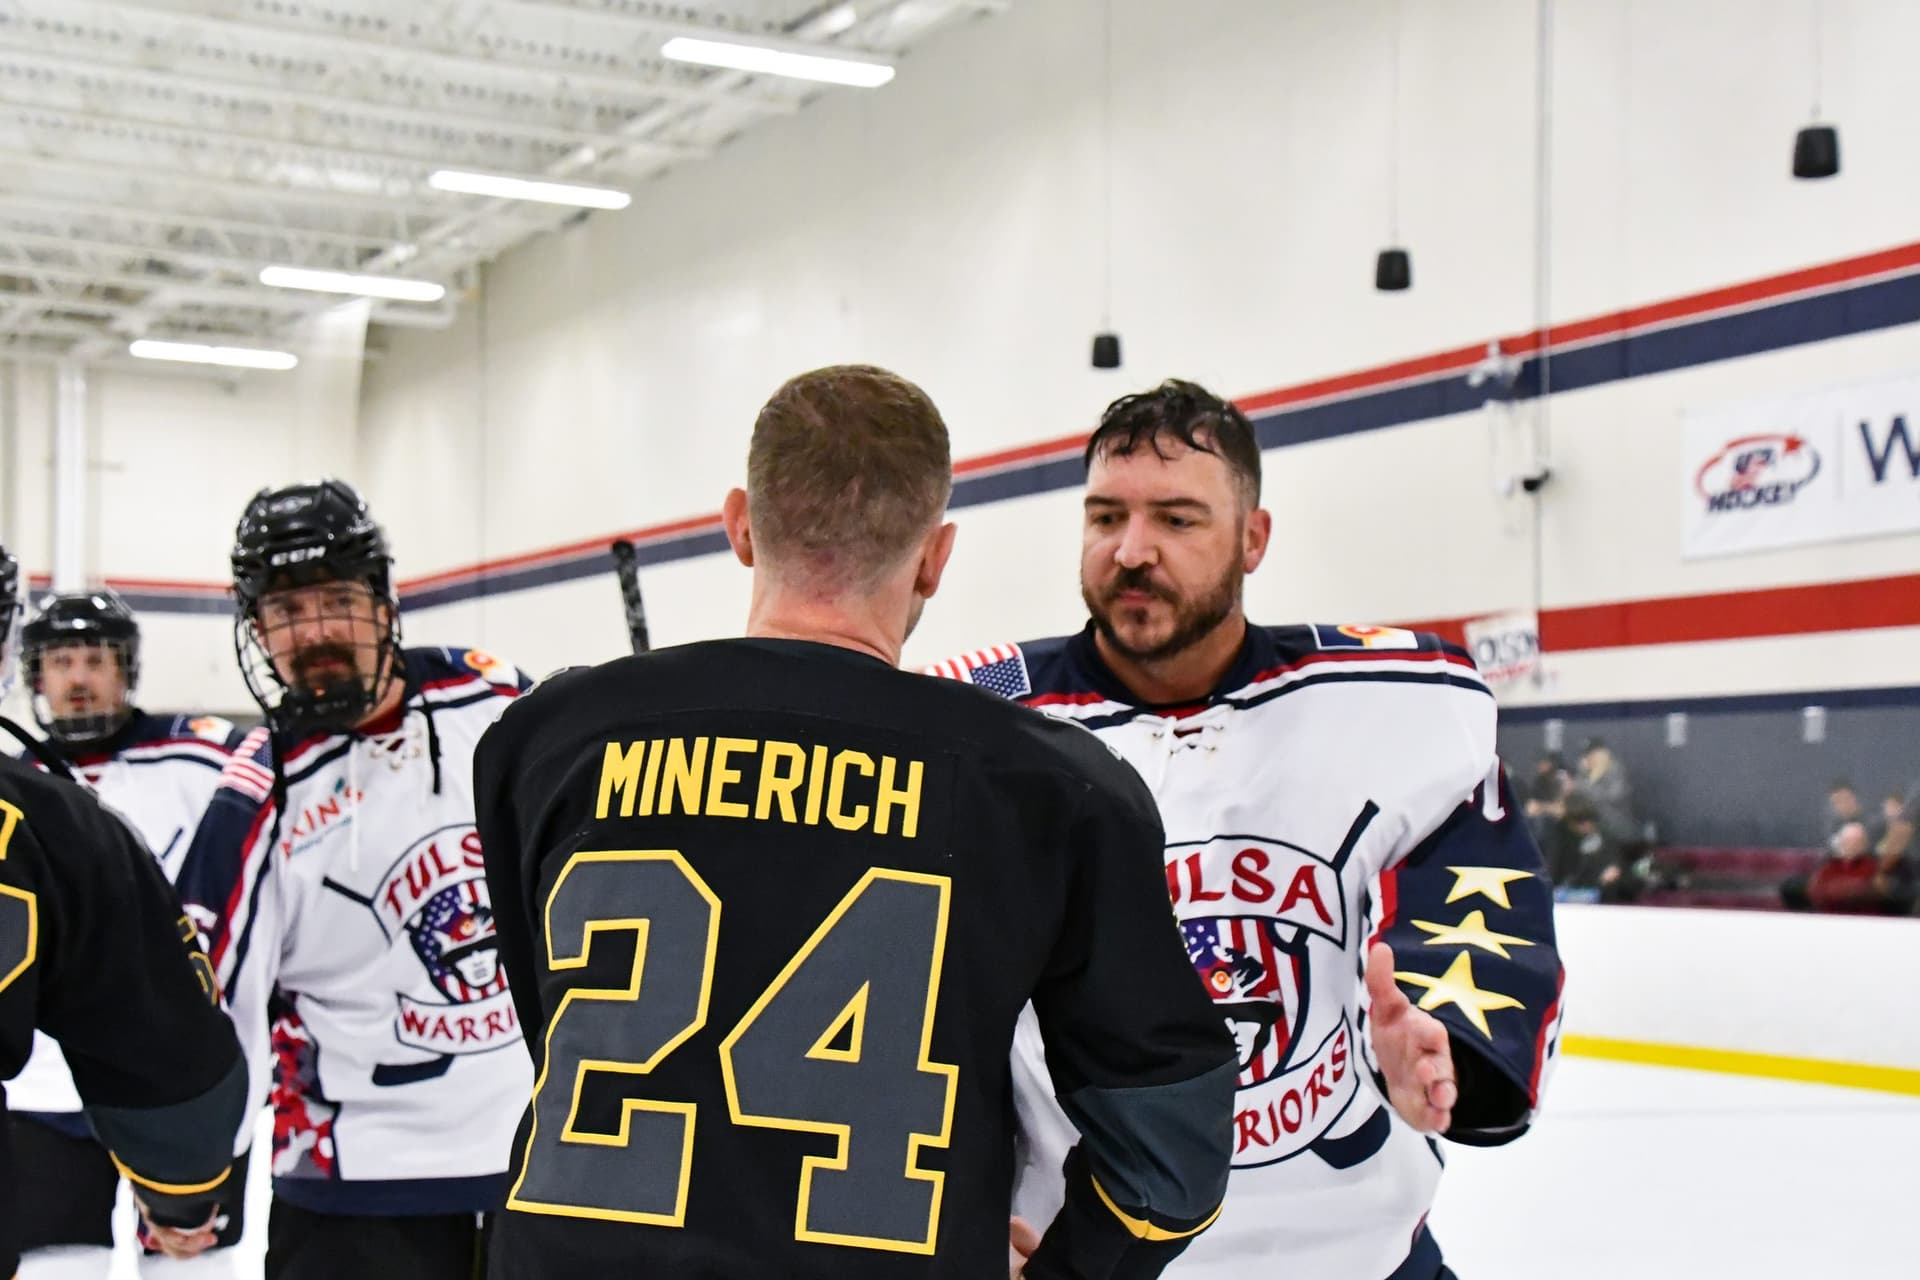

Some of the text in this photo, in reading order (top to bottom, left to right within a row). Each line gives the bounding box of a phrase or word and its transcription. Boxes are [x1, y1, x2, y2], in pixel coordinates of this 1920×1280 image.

[1707, 482, 1801, 512] HOCKEY
[595, 737, 924, 838] MINERICH
[507, 850, 959, 1256] 24
